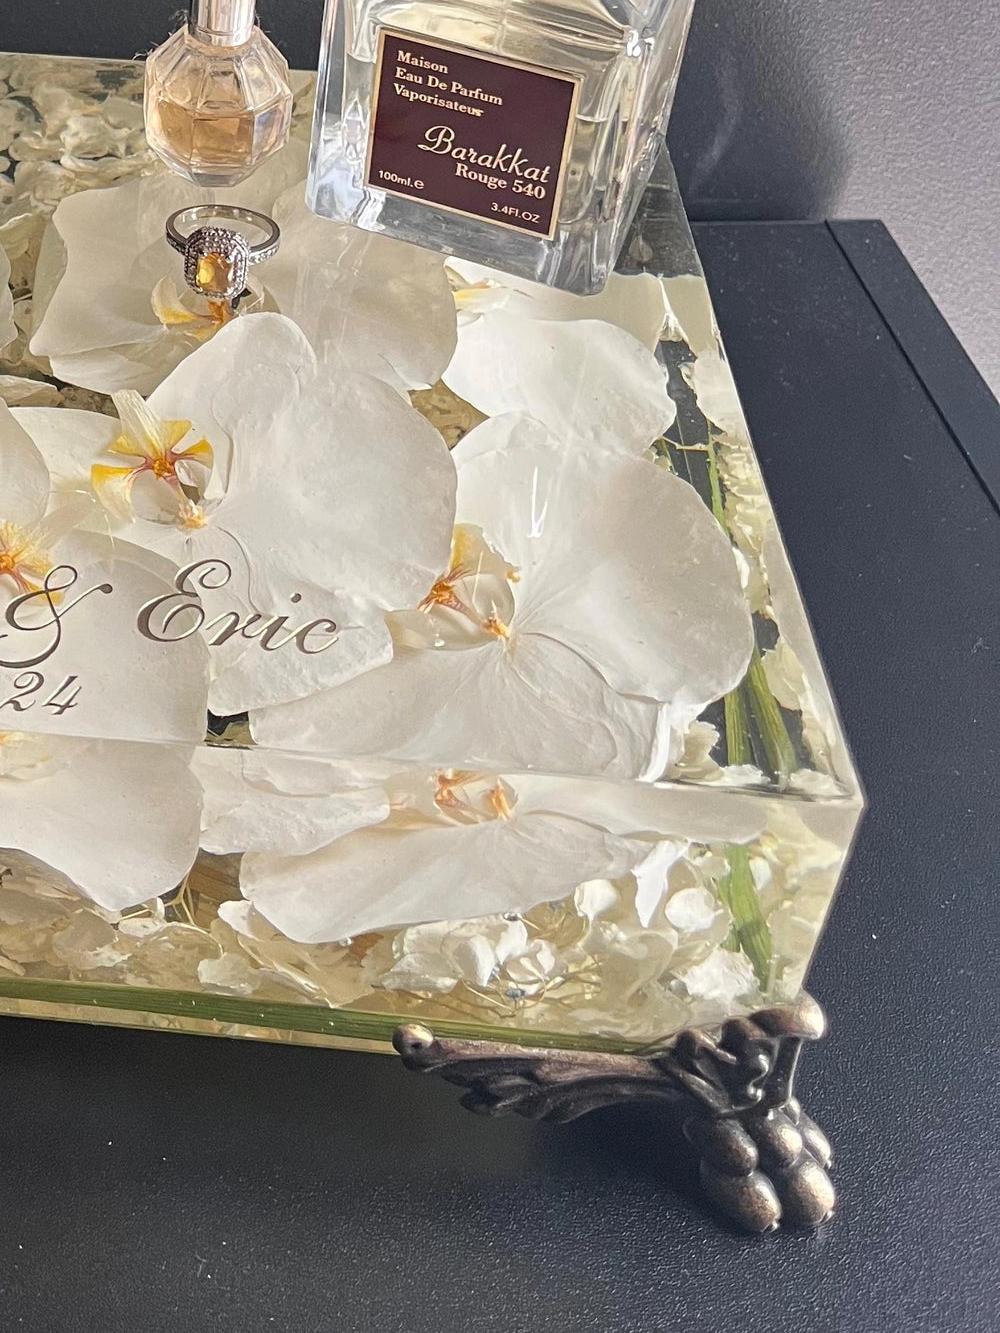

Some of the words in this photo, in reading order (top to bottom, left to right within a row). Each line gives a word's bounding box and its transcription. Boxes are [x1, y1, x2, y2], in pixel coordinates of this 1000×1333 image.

[397, 50, 448, 74] Maison
[393, 83, 484, 117] Vaporisateur
[394, 67, 423, 85] Eau
[427, 75, 447, 91] De
[451, 81, 503, 106] Parfum
[417, 125, 550, 183] Barakkat
[455, 162, 507, 190] Rouge
[512, 180, 546, 200] 540
[136, 557, 342, 657] Eric
